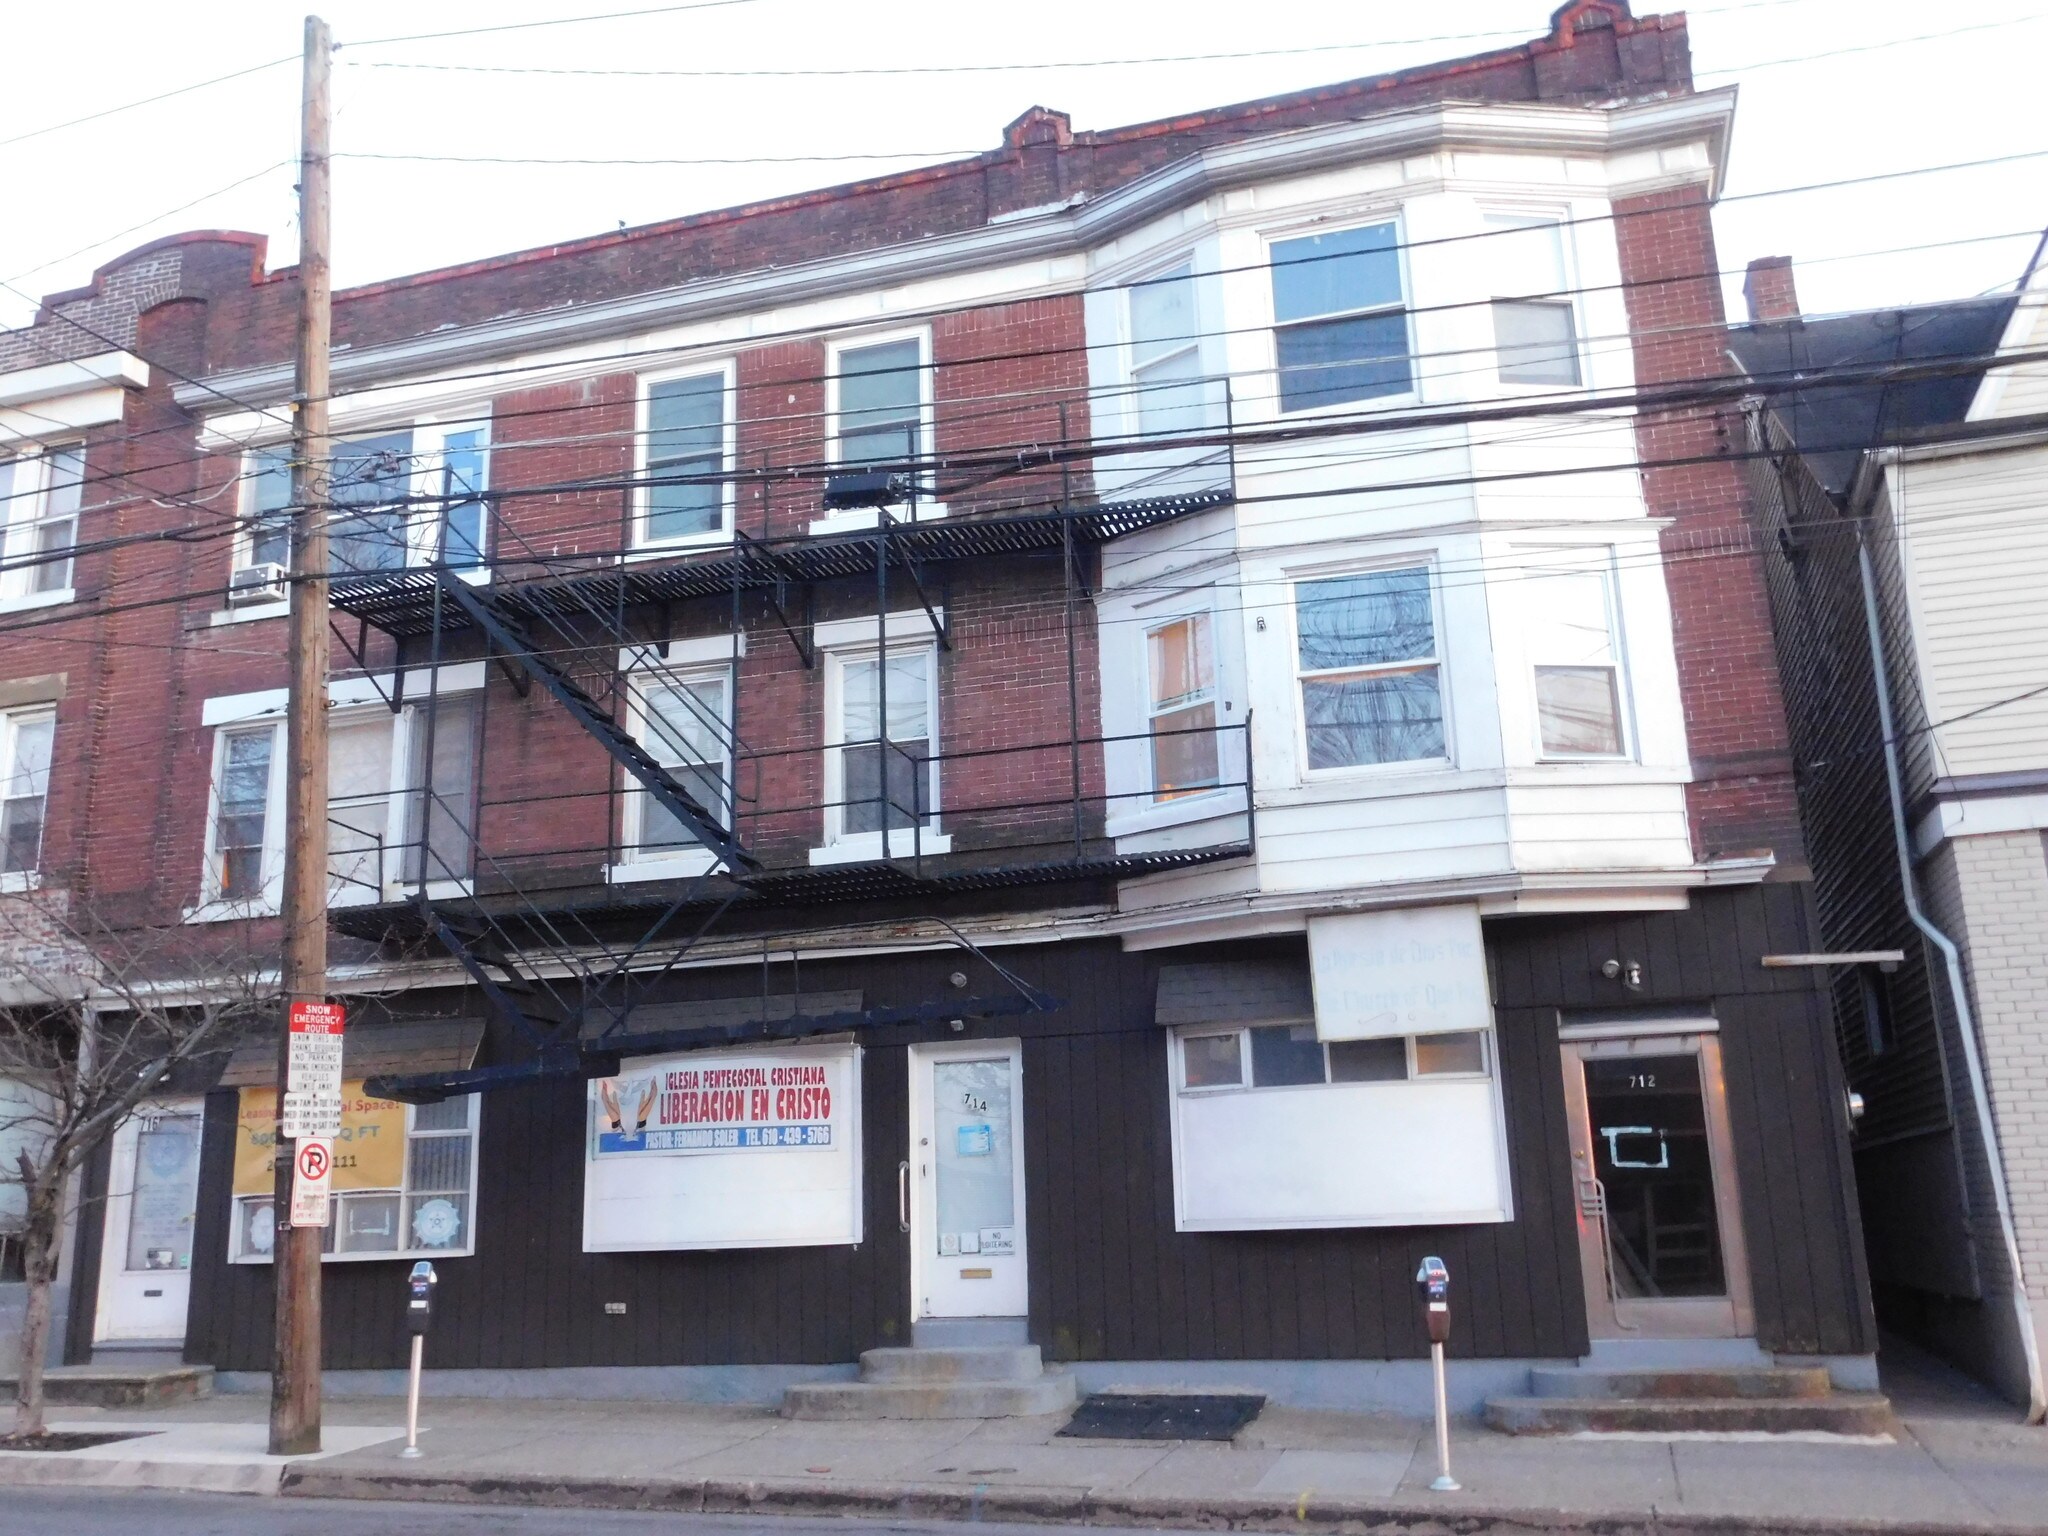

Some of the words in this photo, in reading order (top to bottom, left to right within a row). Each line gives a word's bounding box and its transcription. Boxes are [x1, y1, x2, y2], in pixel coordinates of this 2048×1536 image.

[306, 1004, 331, 1014] SNOW
[294, 1013, 341, 1025] EMERGENCY
[304, 1023, 330, 1034] ROUTE
[293, 1034, 310, 1042] SNOW
[295, 1052, 305, 1062] NO
[309, 1053, 337, 1063] PARKING
[311, 1063, 340, 1072] EMERGENCY
[665, 1071, 699, 1091] IGLESIA
[703, 1067, 767, 1089] PENTECOSTAL
[771, 1066, 826, 1086] CRISTIANA
[1629, 1074, 1656, 1088] 712
[318, 1083, 333, 1091] AWAY
[285, 1099, 298, 1108] MON
[660, 1090, 745, 1125] LIBERACION
[751, 1089, 769, 1121] EN
[776, 1087, 831, 1121] CRISTO
[964, 1093, 987, 1112] 714
[284, 1110, 297, 1119] WED
[283, 1121, 295, 1130] FRI
[319, 1121, 328, 1129] SAT
[359, 1125, 381, 1138] FT
[674, 1129, 713, 1148] FERNANDO
[714, 1129, 739, 1147] SOLER
[992, 1231, 1002, 1240] NO
[981, 1240, 1013, 1249] LOITERING
